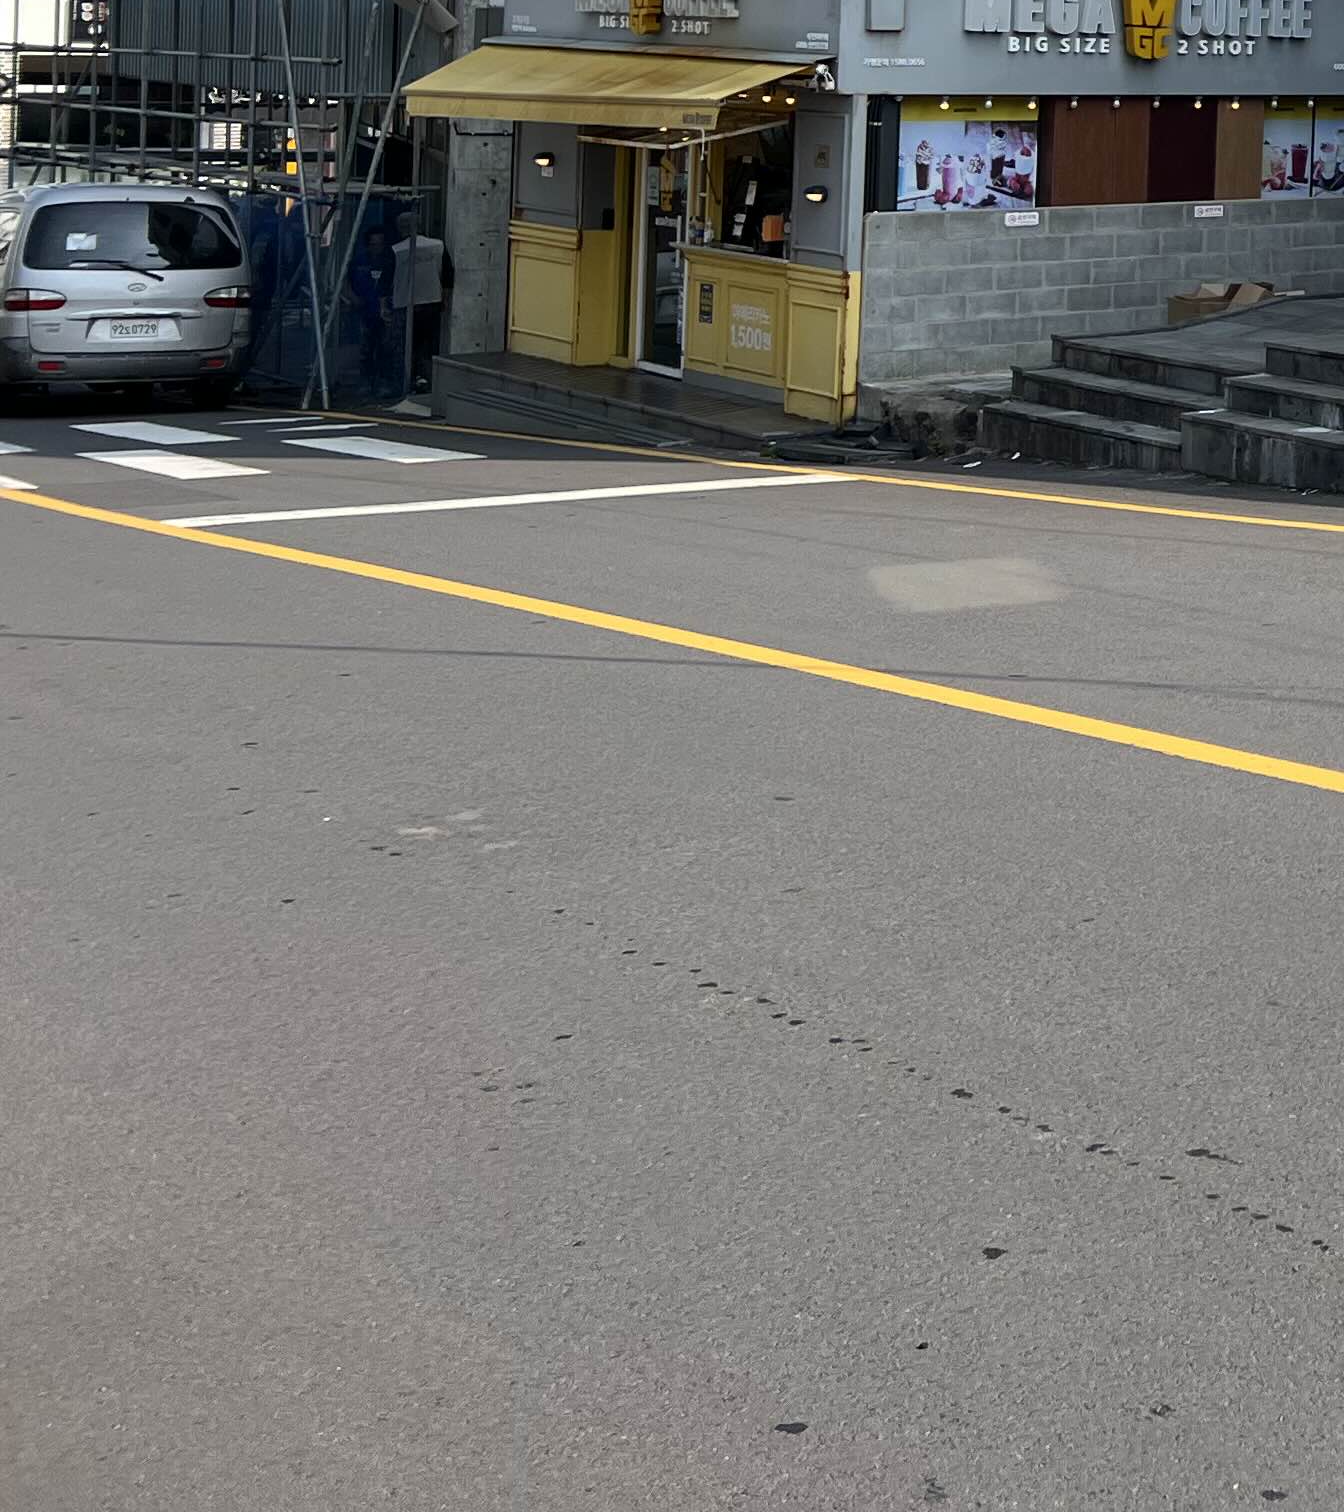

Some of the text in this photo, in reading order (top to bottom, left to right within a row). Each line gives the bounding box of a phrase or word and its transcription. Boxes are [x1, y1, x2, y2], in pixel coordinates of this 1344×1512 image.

[681, 21, 710, 35] SHOT
[1007, 36, 1112, 55] BIG SIZE
[1177, 39, 1257, 57] 2 SHOT
